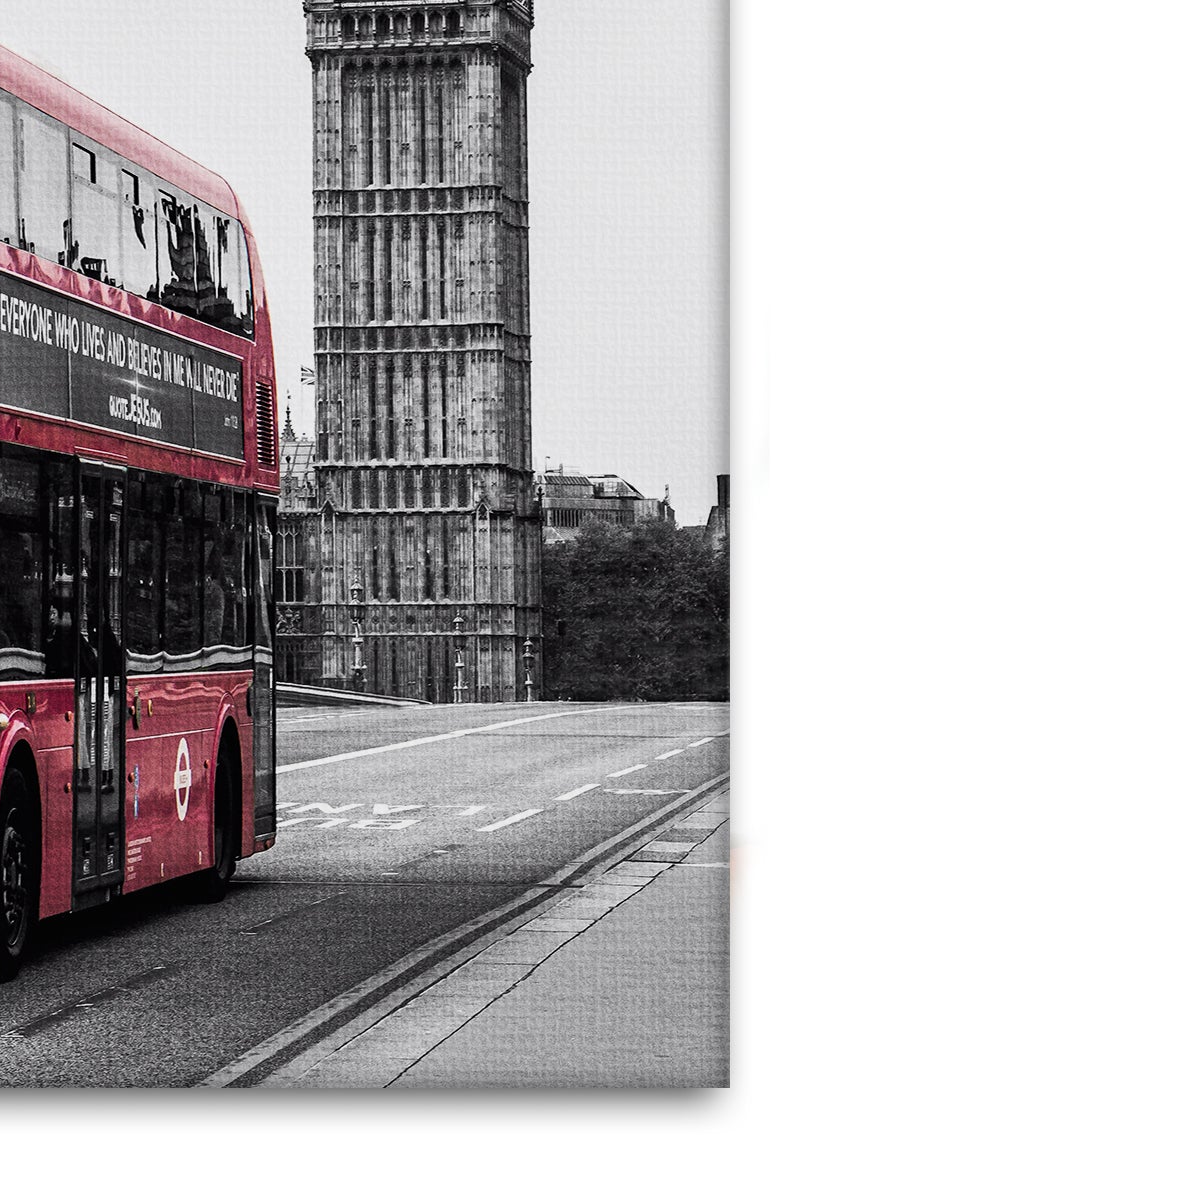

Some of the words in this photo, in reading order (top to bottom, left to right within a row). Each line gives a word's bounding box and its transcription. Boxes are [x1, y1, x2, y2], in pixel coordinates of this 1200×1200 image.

[54, 311, 80, 354] WHO
[81, 320, 106, 363] LIVES
[107, 330, 126, 368] AND
[127, 336, 162, 381] BELIEVES
[163, 350, 173, 384] IN
[173, 353, 185, 387] ME
[203, 363, 226, 399] NEVER
[276, 818, 422, 830] BU
